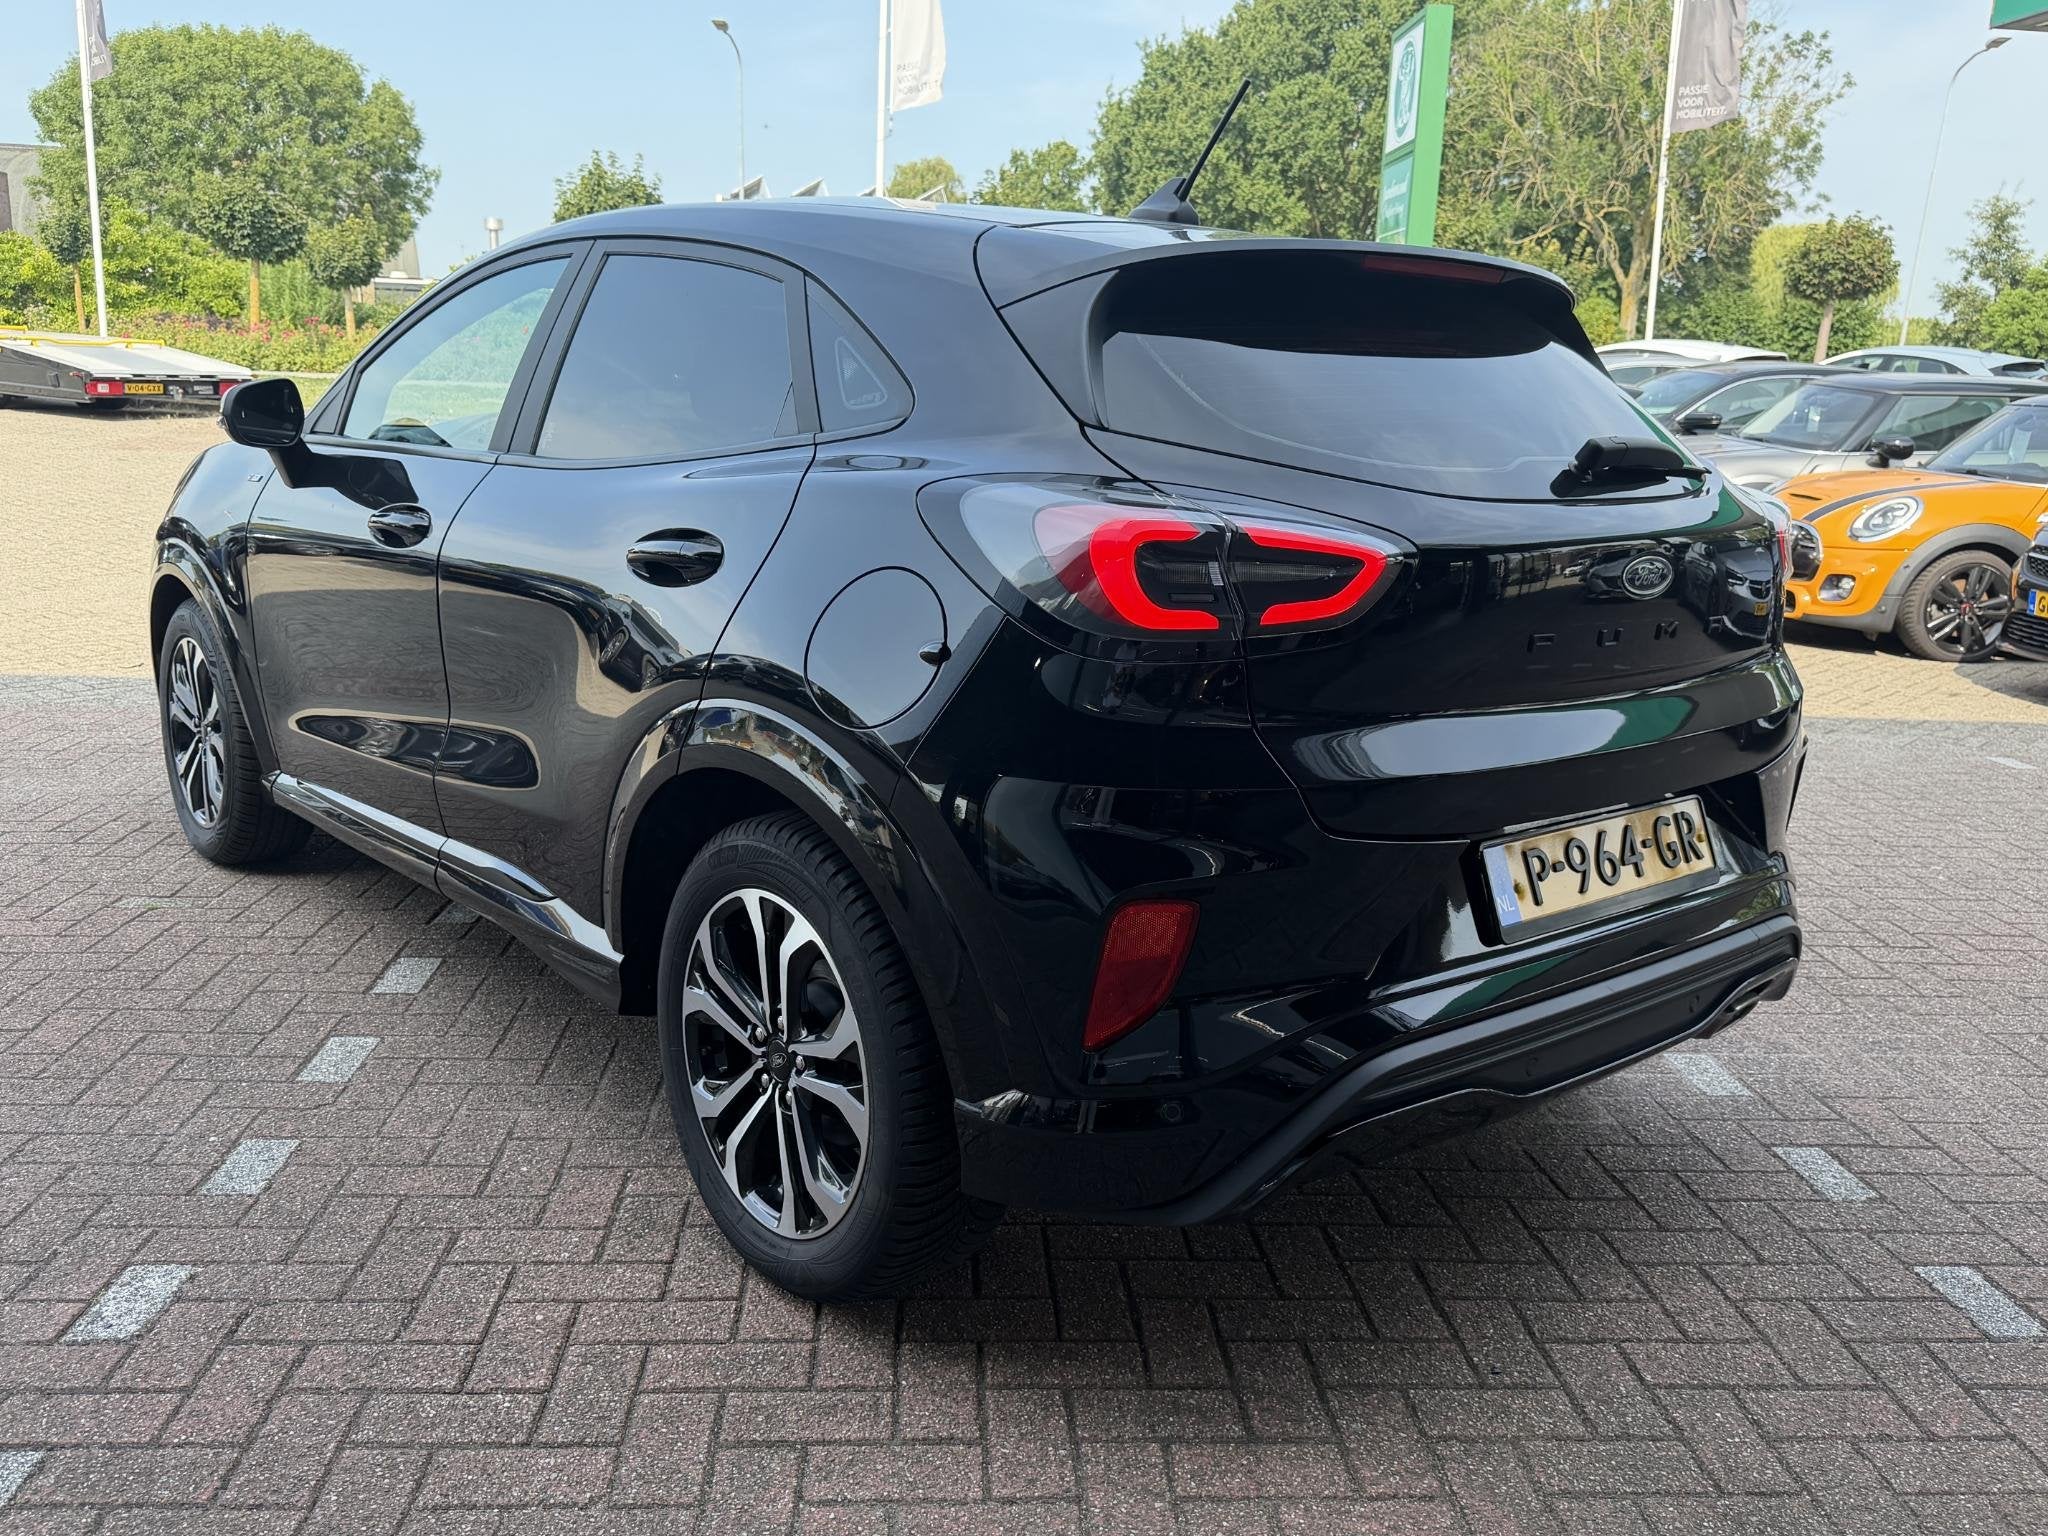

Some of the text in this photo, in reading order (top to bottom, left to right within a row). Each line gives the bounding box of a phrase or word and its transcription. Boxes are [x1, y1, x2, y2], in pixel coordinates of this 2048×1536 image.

[1679, 84, 1710, 97] PASSIE
[1677, 97, 1704, 109] VOOR
[1521, 811, 1705, 907] P-964-GR
[1498, 894, 1515, 912] NL
